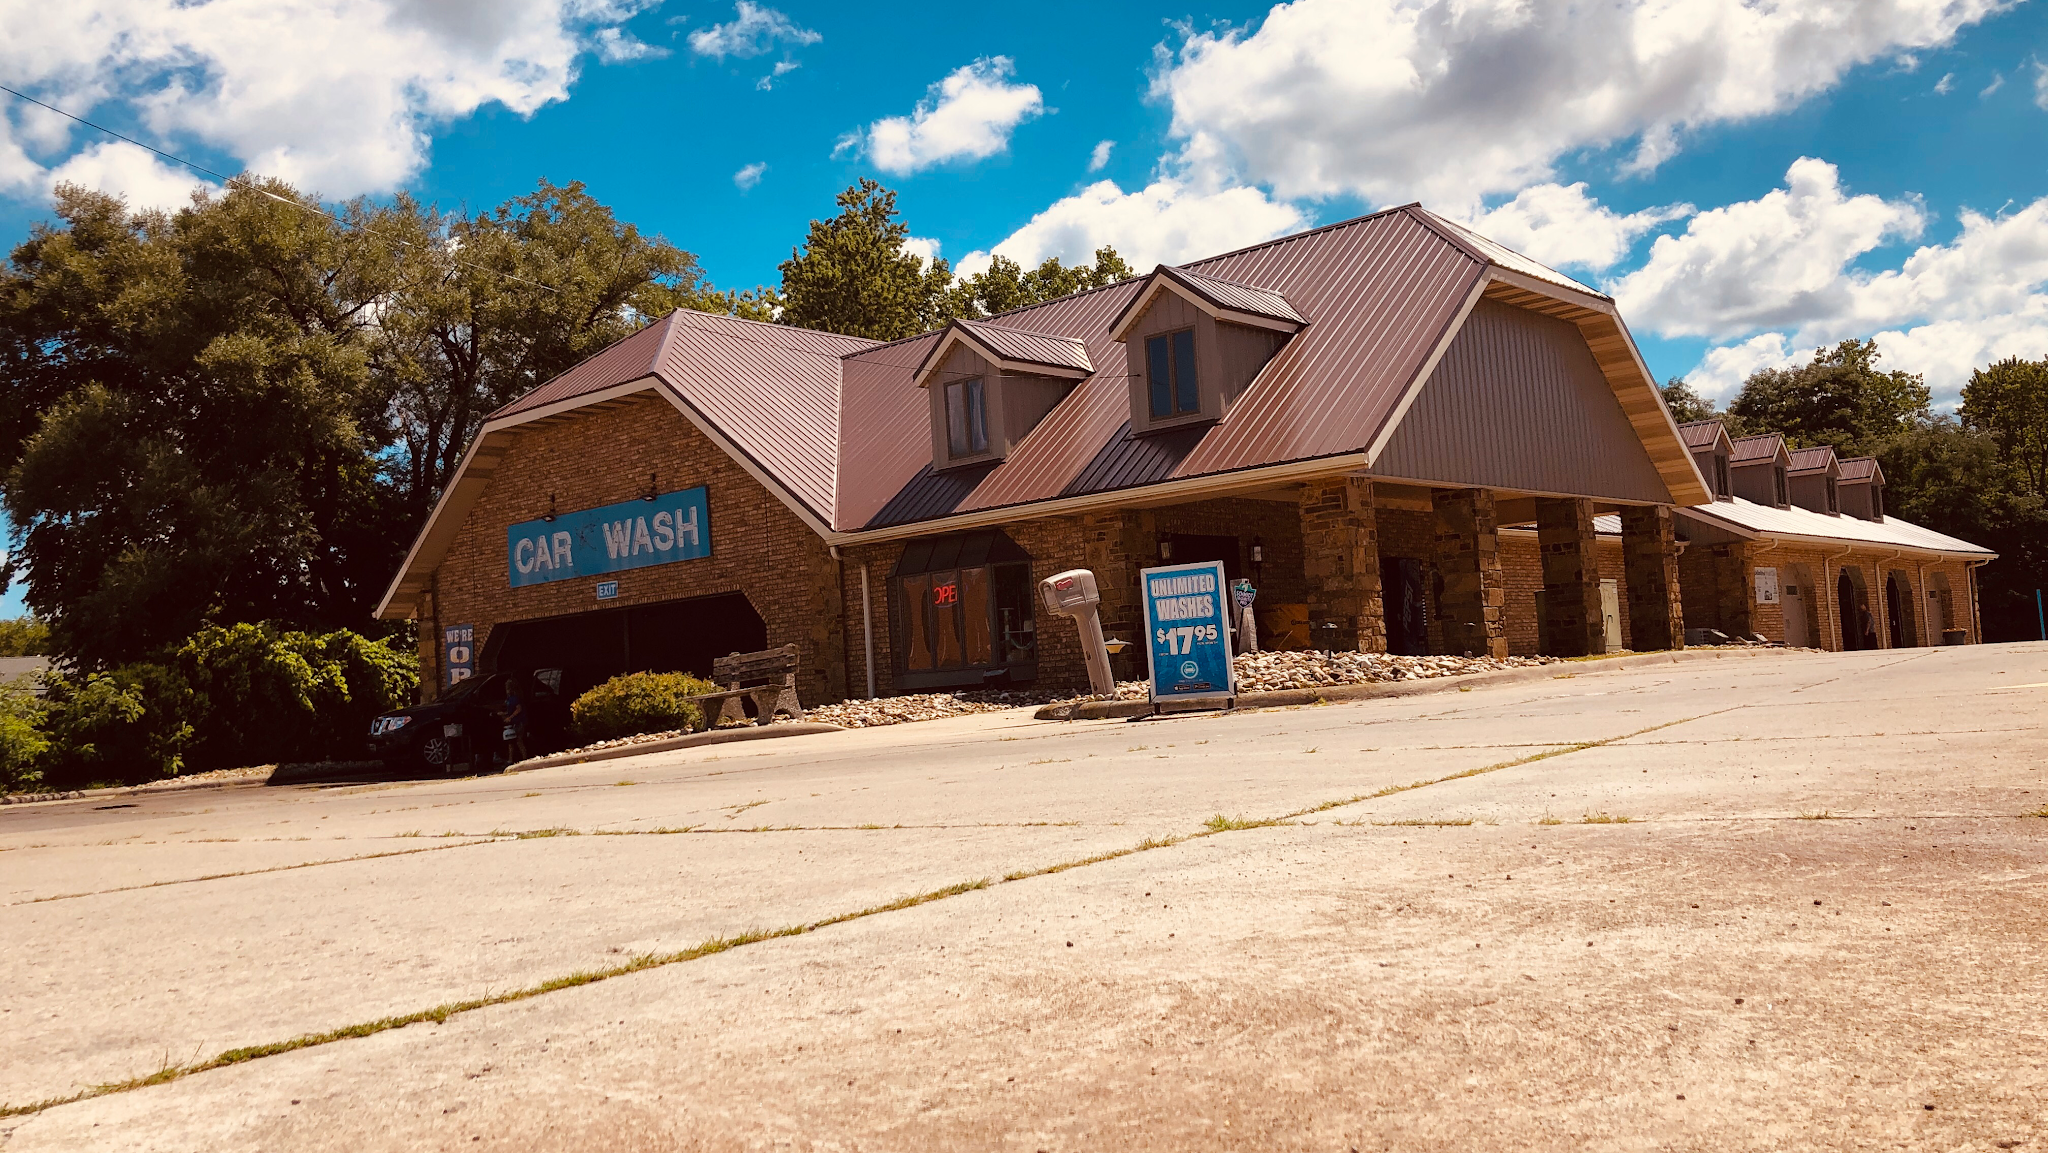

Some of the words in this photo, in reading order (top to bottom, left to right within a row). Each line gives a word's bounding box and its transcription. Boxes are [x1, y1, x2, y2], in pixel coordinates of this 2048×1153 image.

[515, 531, 574, 573] CAR
[603, 507, 699, 559] WASH
[598, 583, 617, 597] EXIT
[1151, 574, 1216, 597] UNLIMITED
[1156, 595, 1214, 621] WASHES
[446, 628, 473, 644] WE'RE
